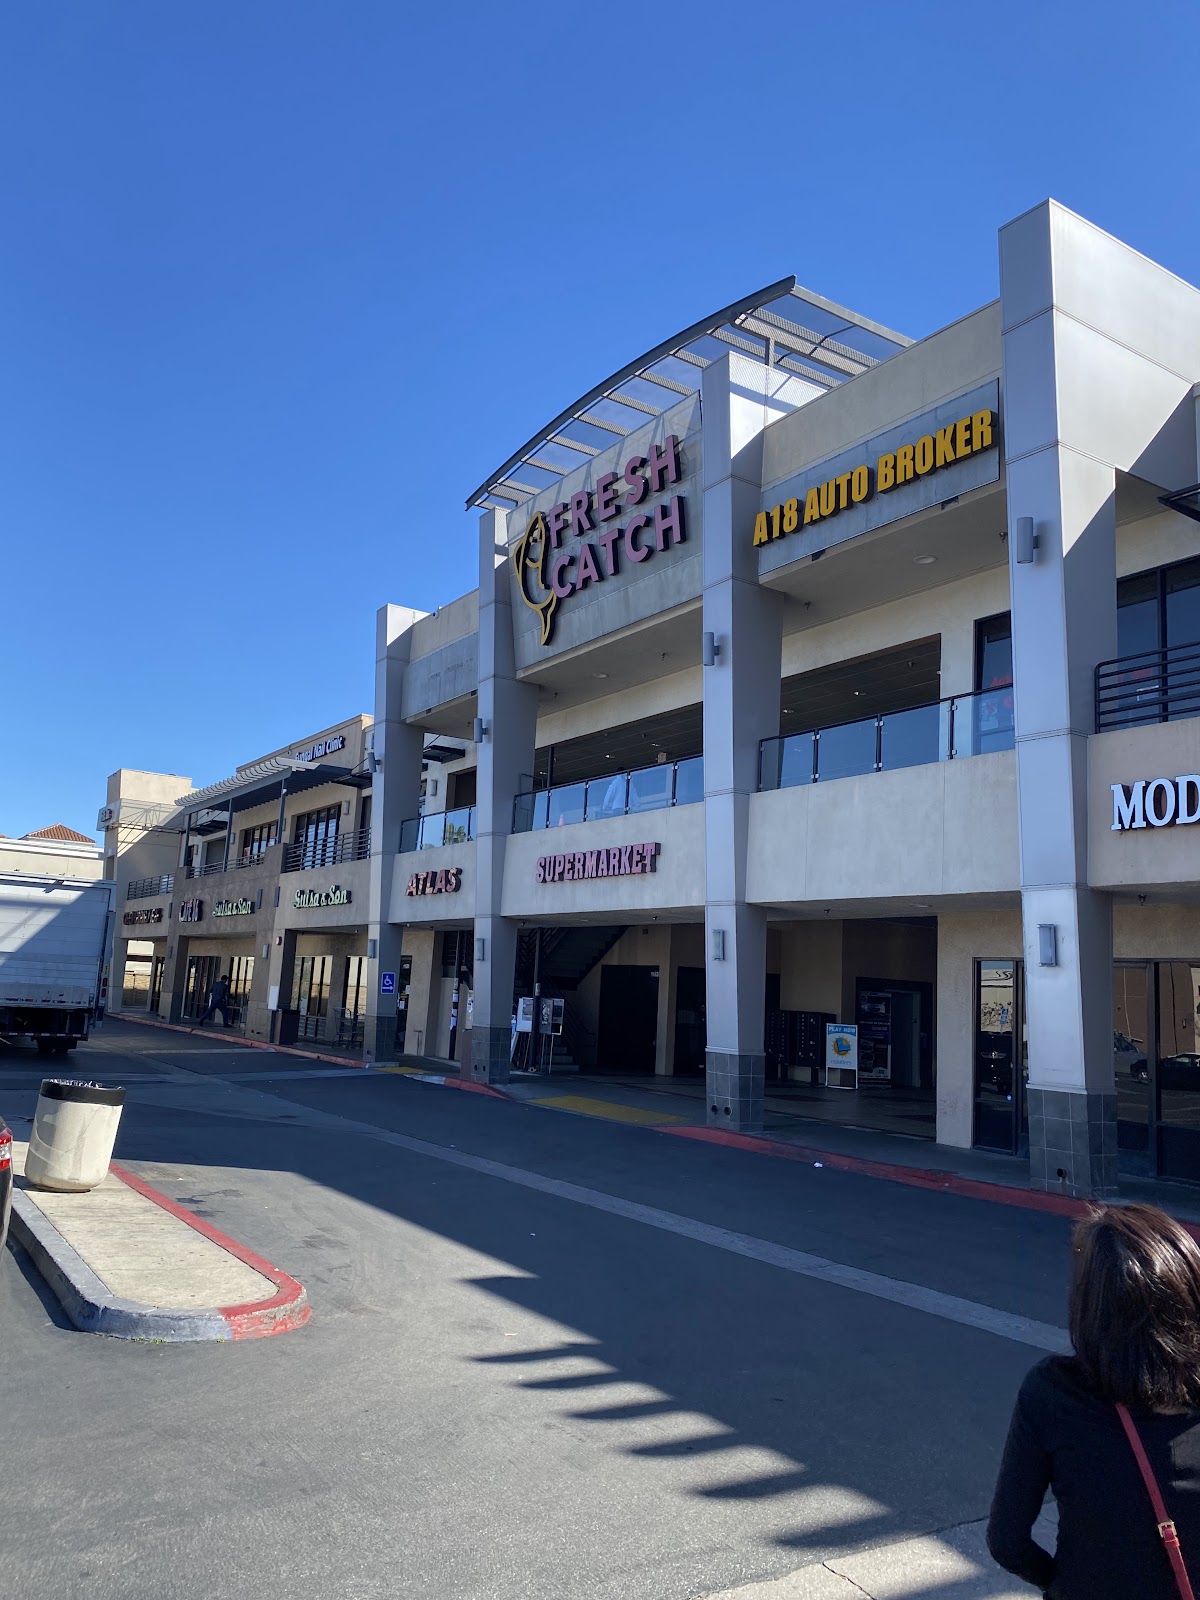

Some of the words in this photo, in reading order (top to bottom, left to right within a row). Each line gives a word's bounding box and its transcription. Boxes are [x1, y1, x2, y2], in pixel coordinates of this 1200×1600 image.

[550, 434, 681, 548] FRESH
[753, 497, 800, 547] A18
[804, 464, 871, 525] AUTO
[877, 408, 995, 494] BROKER
[552, 495, 685, 598] CATCH
[313, 741, 326, 759] Nail
[326, 735, 344, 754] Clinic
[1110, 774, 1200, 831] MOD
[405, 867, 461, 896] ATLAS
[536, 842, 660, 884] SUPERMARKET
[238, 898, 251, 915] Son
[292, 889, 320, 908] Luisa
[320, 892, 328, 906] &
[328, 885, 349, 905] Son
